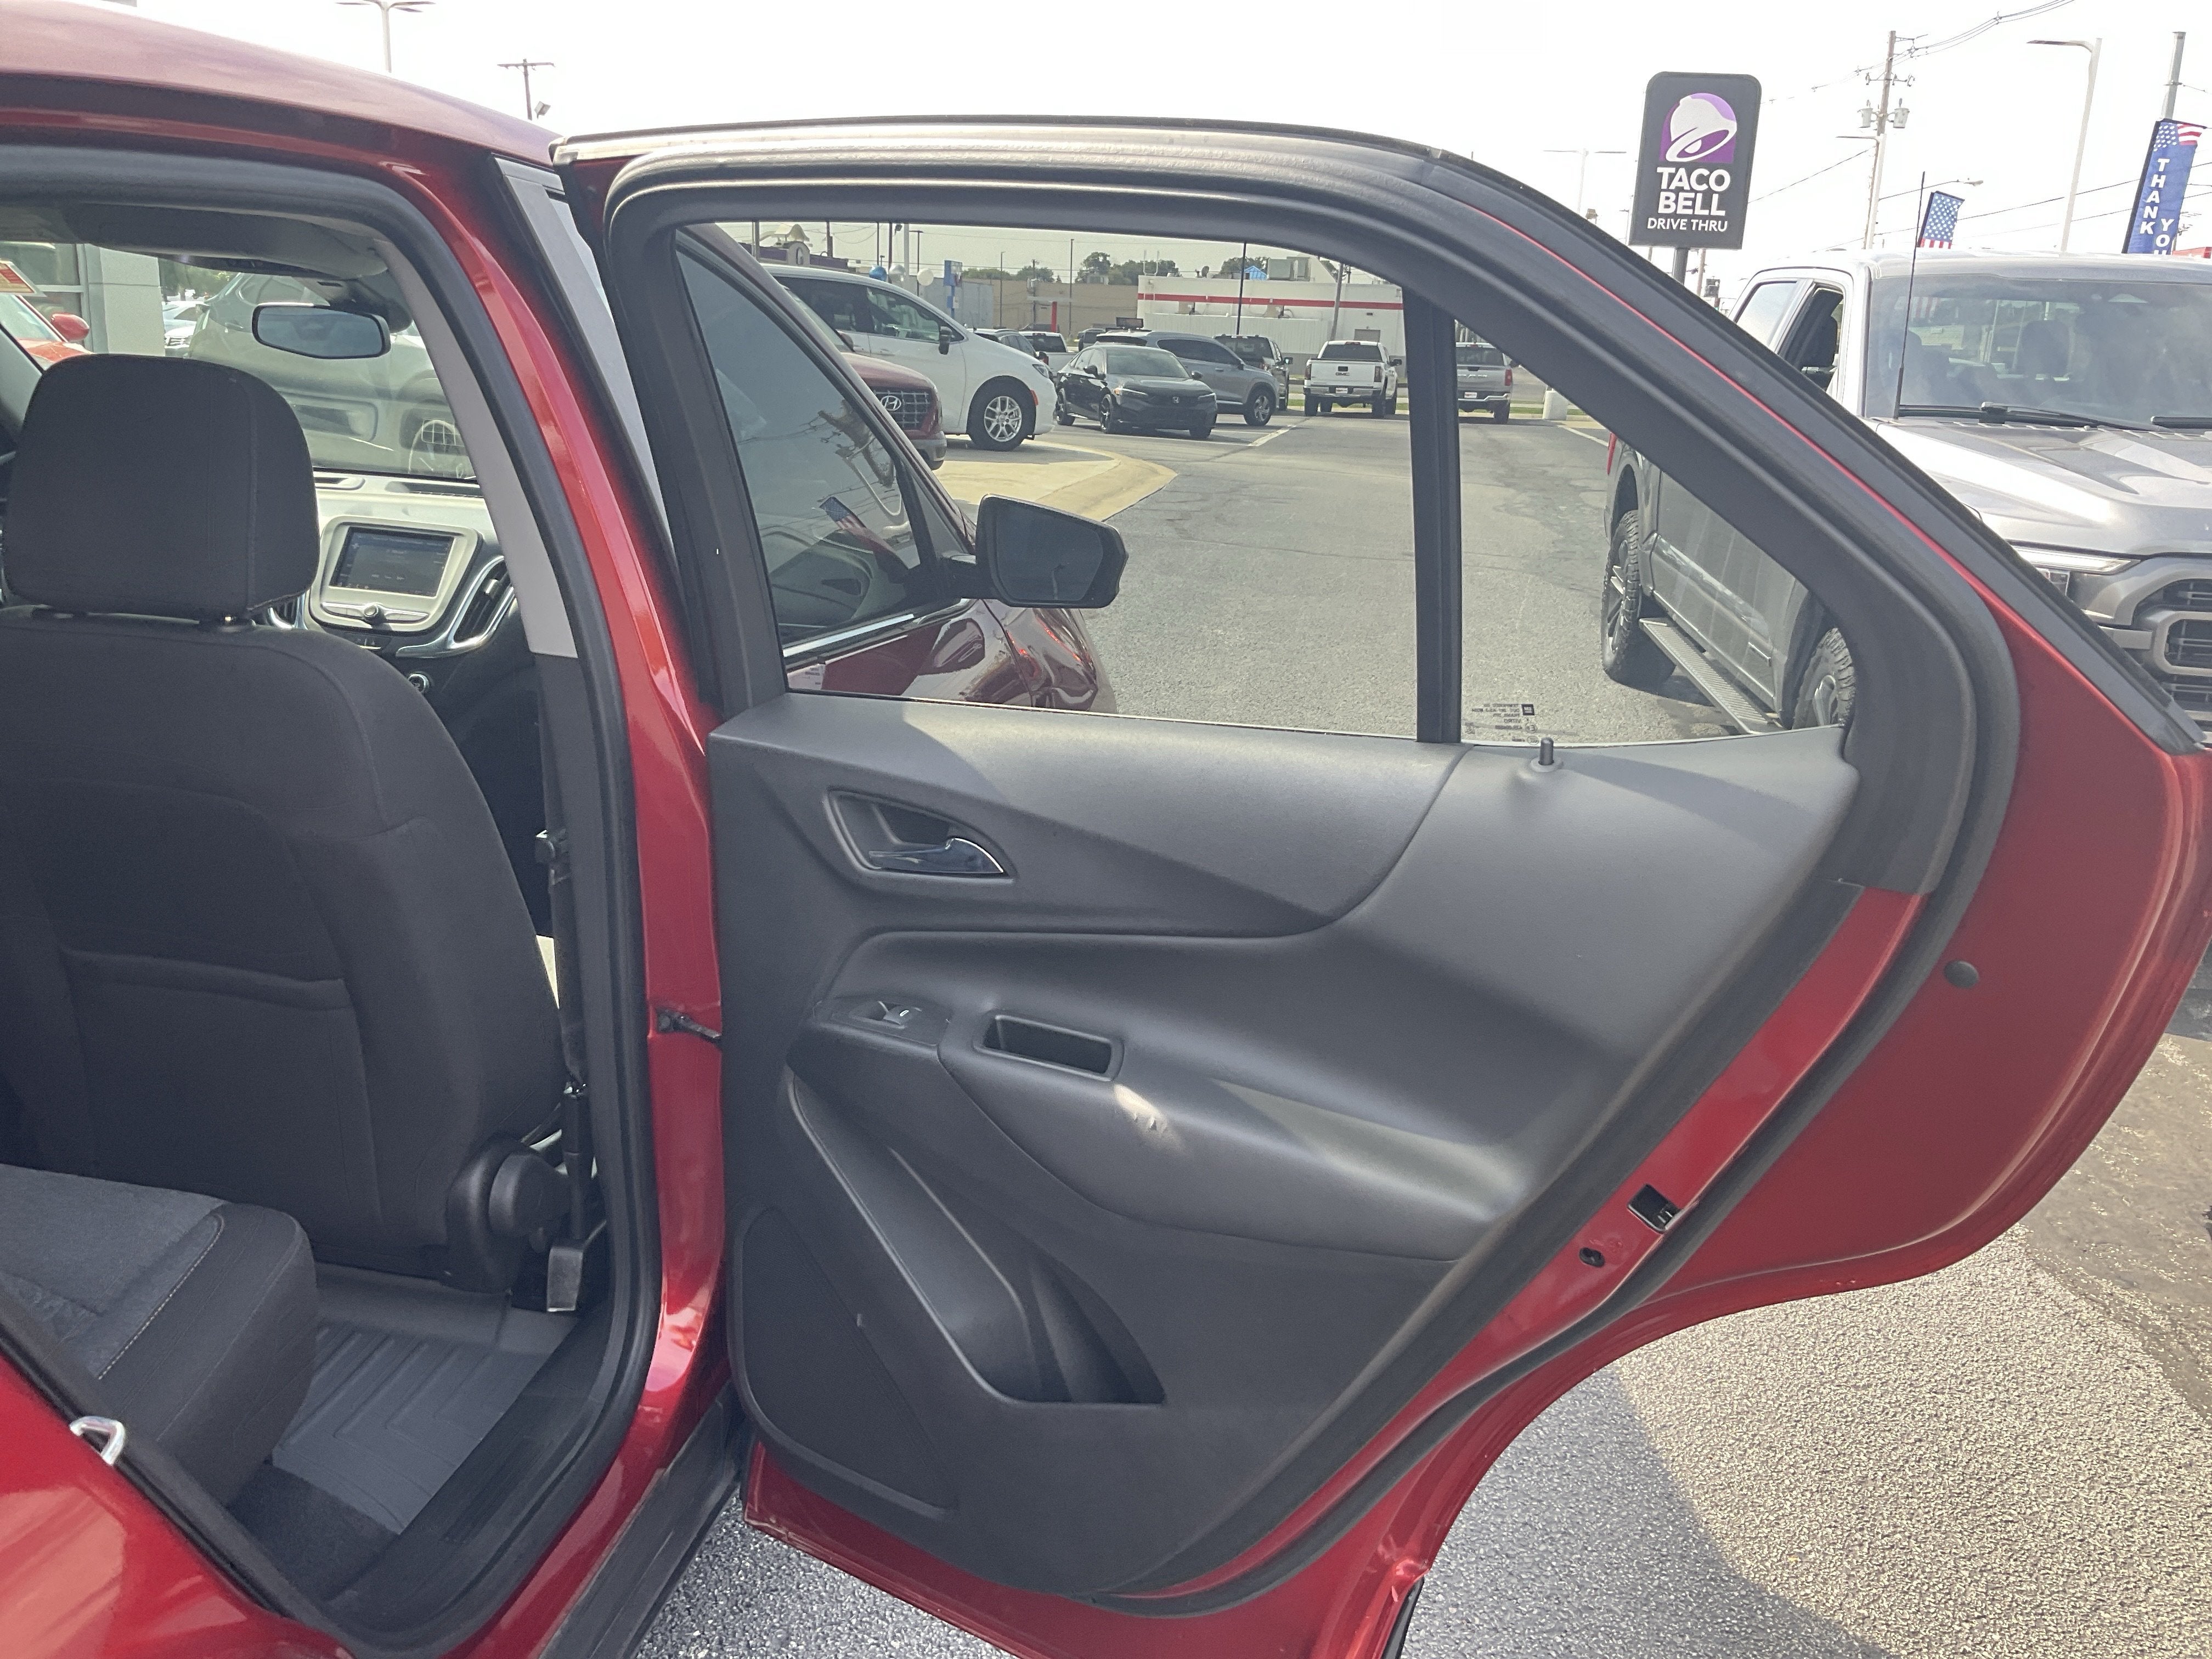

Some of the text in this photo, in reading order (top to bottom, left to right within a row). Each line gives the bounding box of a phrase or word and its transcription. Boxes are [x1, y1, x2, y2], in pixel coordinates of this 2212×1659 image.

[1657, 167, 1730, 191] TACO
[1658, 192, 1725, 216] BELL
[2140, 159, 2170, 234] THANK
[1647, 218, 1728, 232] DRIVE THRU
